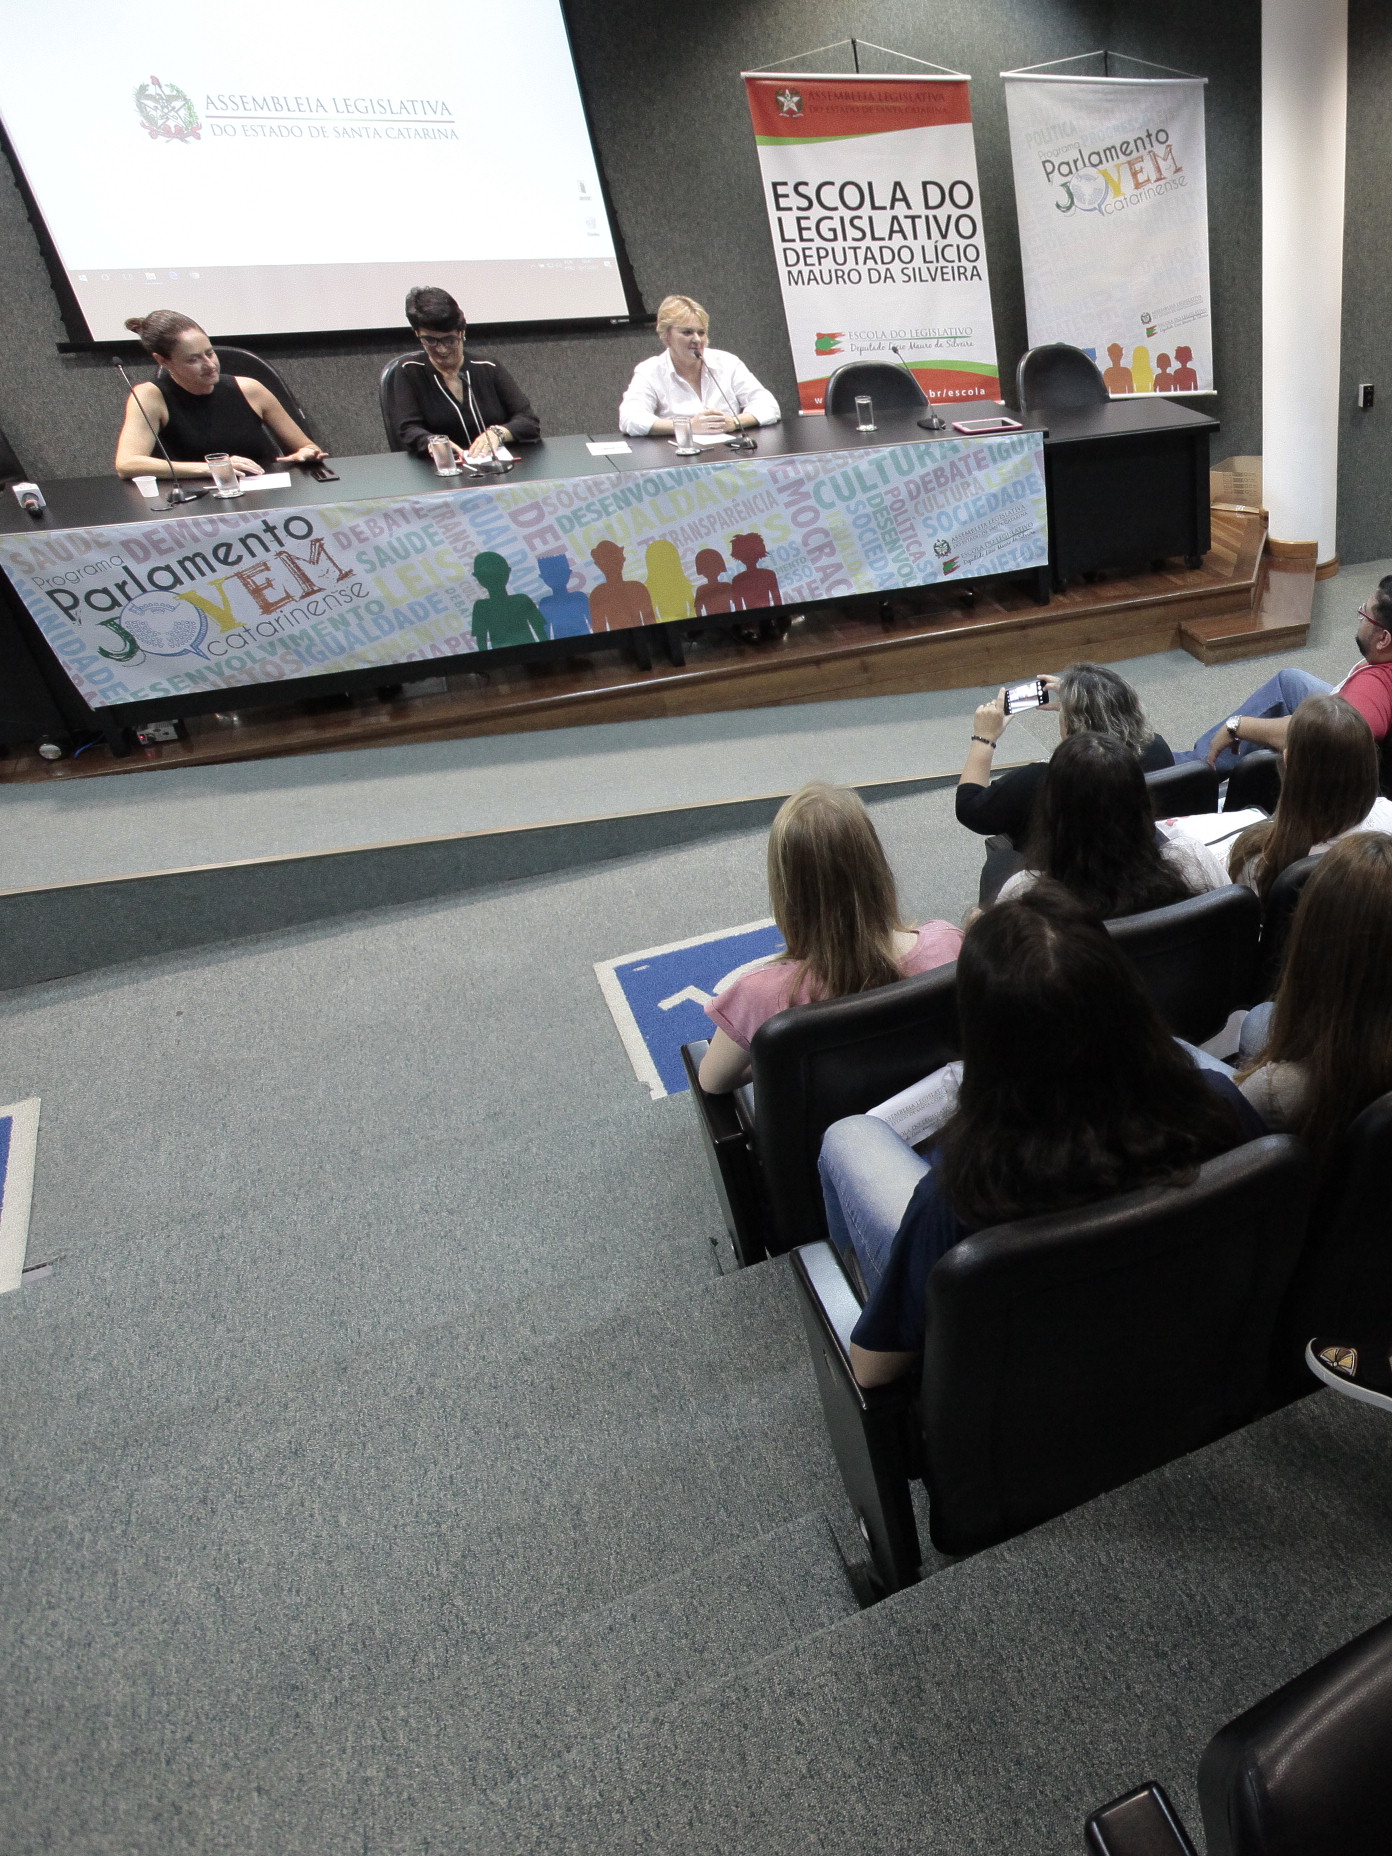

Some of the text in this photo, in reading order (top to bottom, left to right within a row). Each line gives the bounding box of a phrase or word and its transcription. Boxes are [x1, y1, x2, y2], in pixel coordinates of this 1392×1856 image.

[206, 94, 453, 116] ASSEMBLEIA LEGISLATIVA
[808, 90, 945, 102] ASSEMBLEIA LEGISLATIVA
[210, 123, 460, 141] DO ESTADO DE SANTA CATARINA
[1038, 141, 1081, 160] Programa
[1042, 128, 1170, 183] Parlamento
[771, 180, 975, 212] ESCOLA DO
[1055, 144, 1183, 214] JOVEM
[1104, 175, 1189, 215] catarinense
[777, 214, 978, 243] LEGISLATIVO
[782, 240, 981, 268] DEPUTADO LÍCIO
[787, 265, 983, 286] MAURO DA SILVEIRA
[848, 327, 974, 340] ESCOLA DO LEGISLATIVO
[850, 341, 886, 356] Deputado
[909, 341, 932, 350] Mauro
[945, 338, 975, 349] Silveira
[904, 448, 991, 501] DEBATE
[984, 455, 1034, 489] LEIS
[565, 461, 765, 561] IGUALDADE
[914, 477, 985, 518] CULTURA
[921, 472, 1044, 539] SOCIEDADE
[332, 500, 429, 550] DEBATE
[658, 489, 780, 551] TRANSPARÊNCIA
[884, 485, 927, 564] POLÍTICA
[951, 523, 988, 542] ASSEMBLEIA
[988, 504, 1026, 525] LEGISLATIVA
[960, 521, 1034, 559] ESCOLA DO LEGISLATIVO
[45, 515, 314, 622] Parlamento
[355, 523, 446, 574] SAÚDE
[31, 554, 126, 591] Programa
[372, 549, 467, 607] LEIS
[96, 537, 356, 665] JOVEM
[207, 582, 370, 656] catarinense
[290, 592, 450, 667] IGUALDADE
